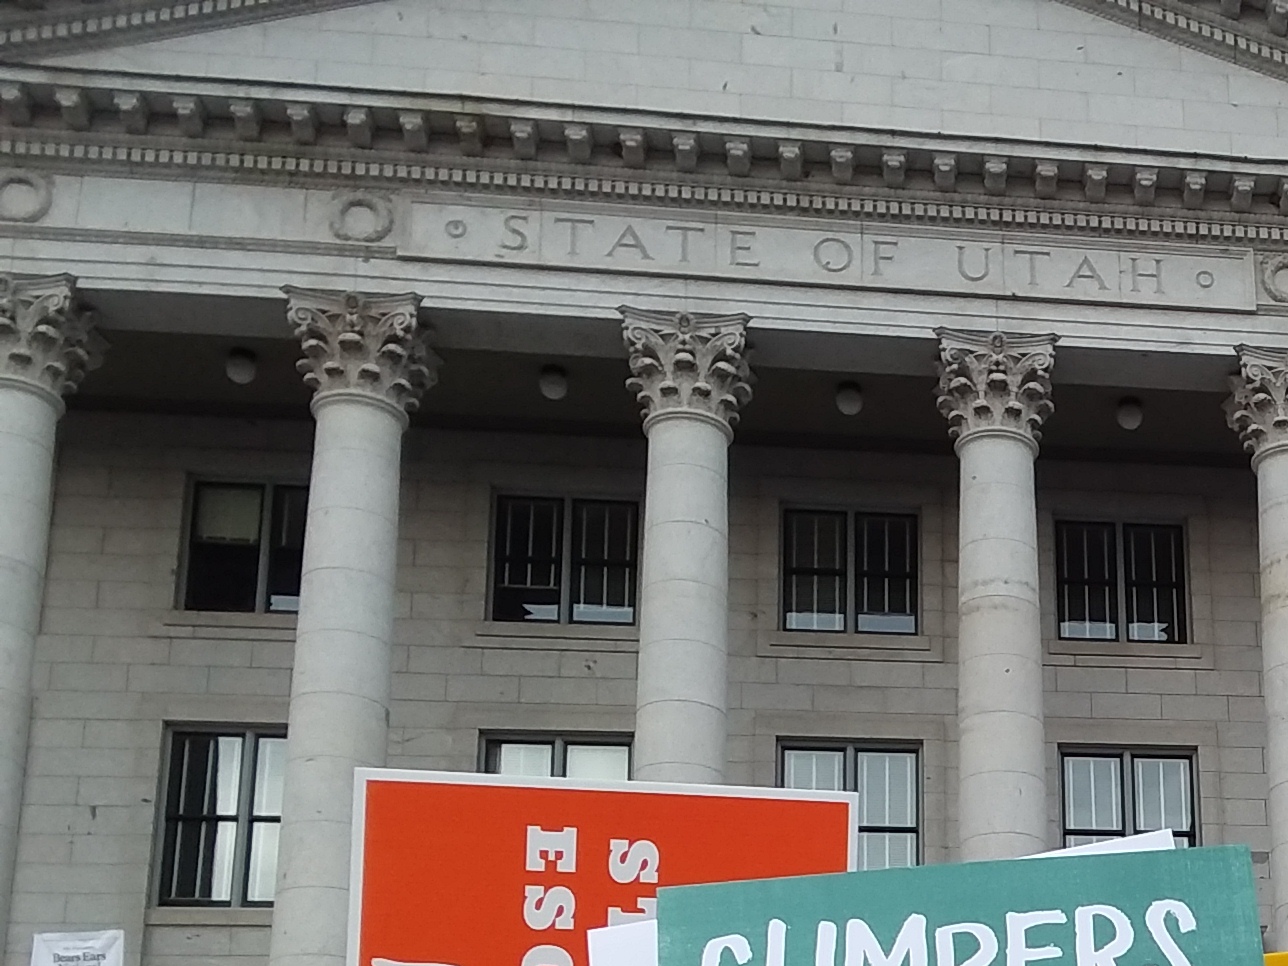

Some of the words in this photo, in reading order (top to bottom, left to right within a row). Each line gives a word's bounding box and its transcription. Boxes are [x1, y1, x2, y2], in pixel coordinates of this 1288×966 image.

[498, 214, 762, 268] STATE
[812, 237, 899, 277] OF
[957, 245, 1166, 294] UTAH
[53, 952, 81, 963] Bears
[82, 952, 106, 962] Ears
